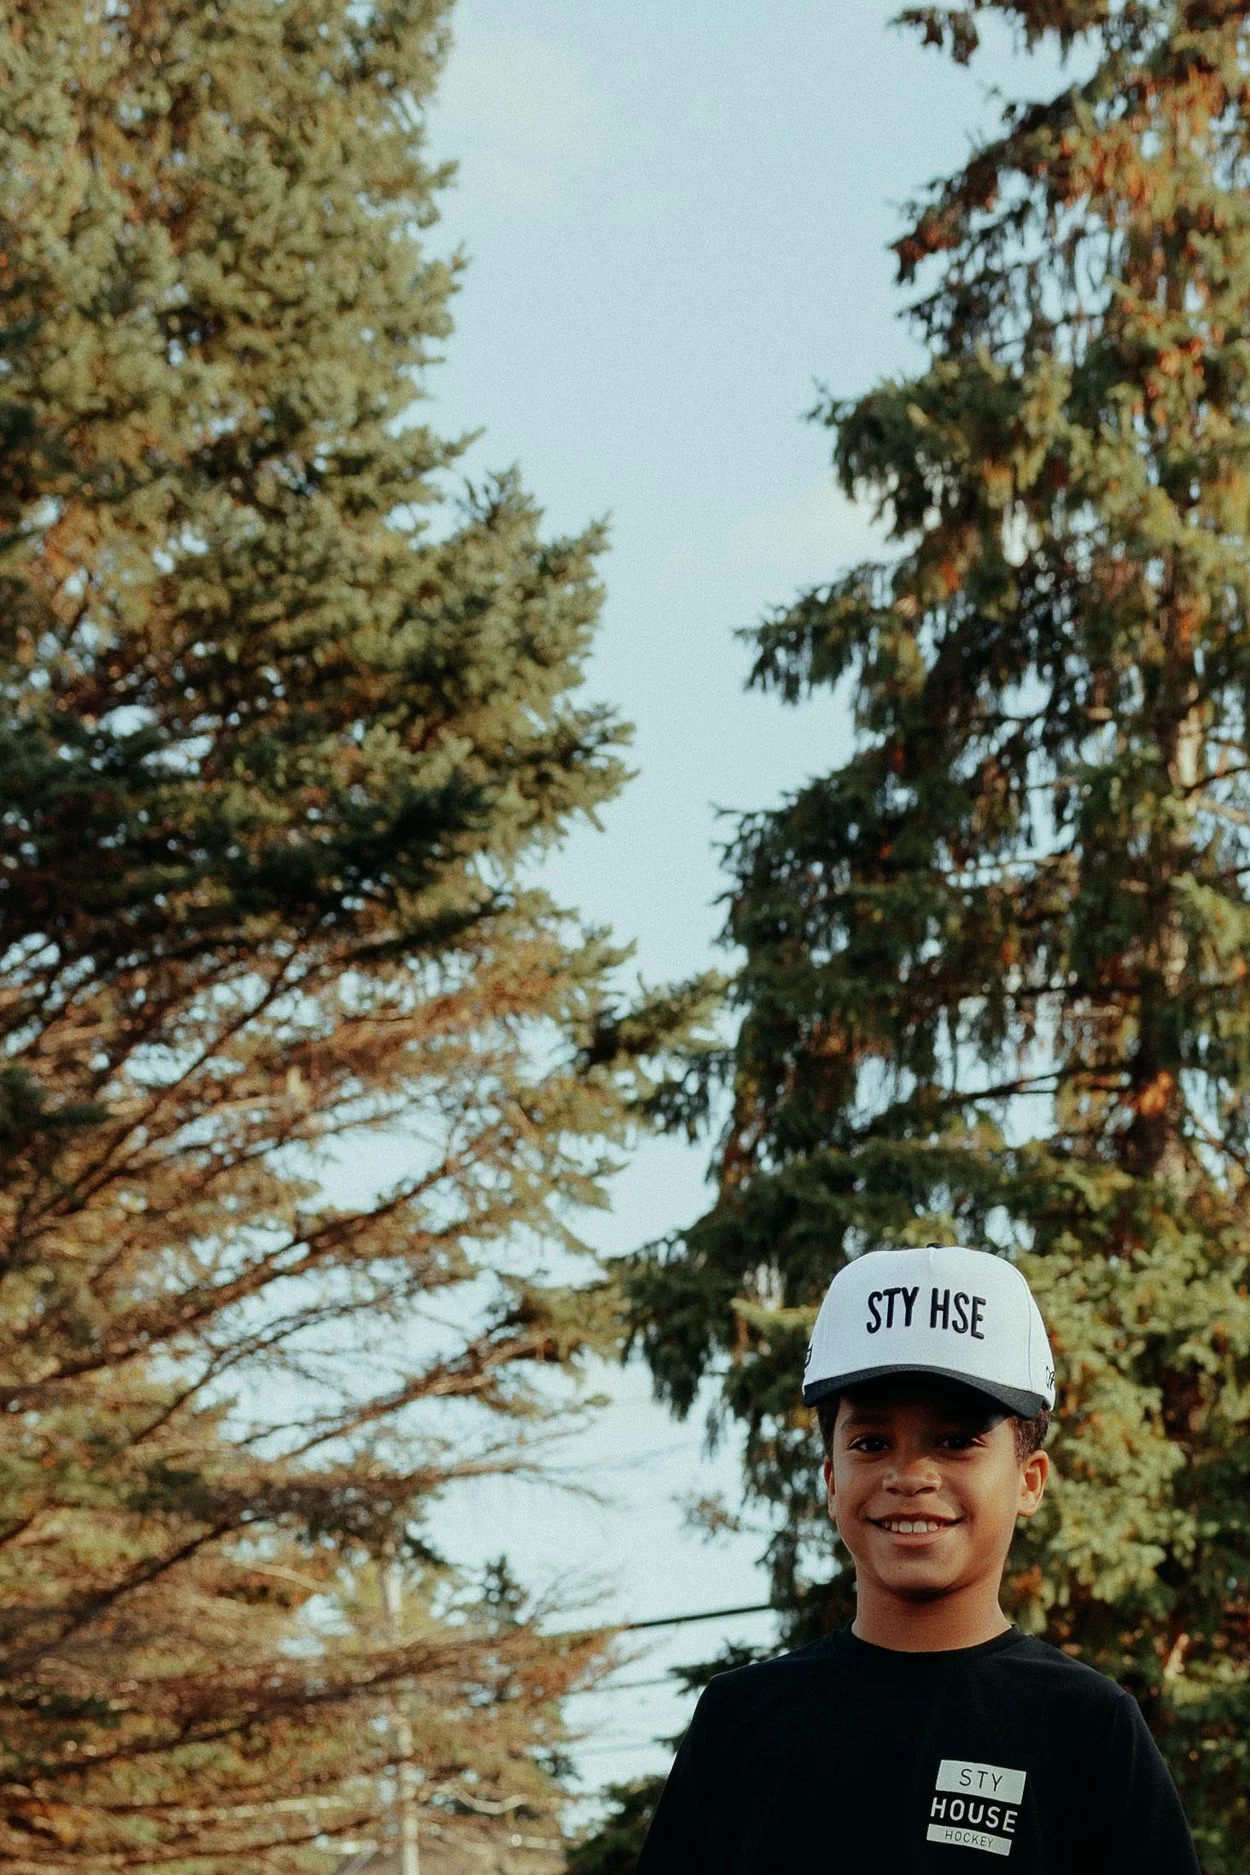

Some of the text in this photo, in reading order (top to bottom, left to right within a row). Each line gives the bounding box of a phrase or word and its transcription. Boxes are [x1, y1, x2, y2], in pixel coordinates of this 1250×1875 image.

[866, 1286, 987, 1340] STY HSE
[959, 1768, 1003, 1792] STY
[930, 1796, 1018, 1833] HOUSE
[945, 1829, 995, 1848] HOCKEY
